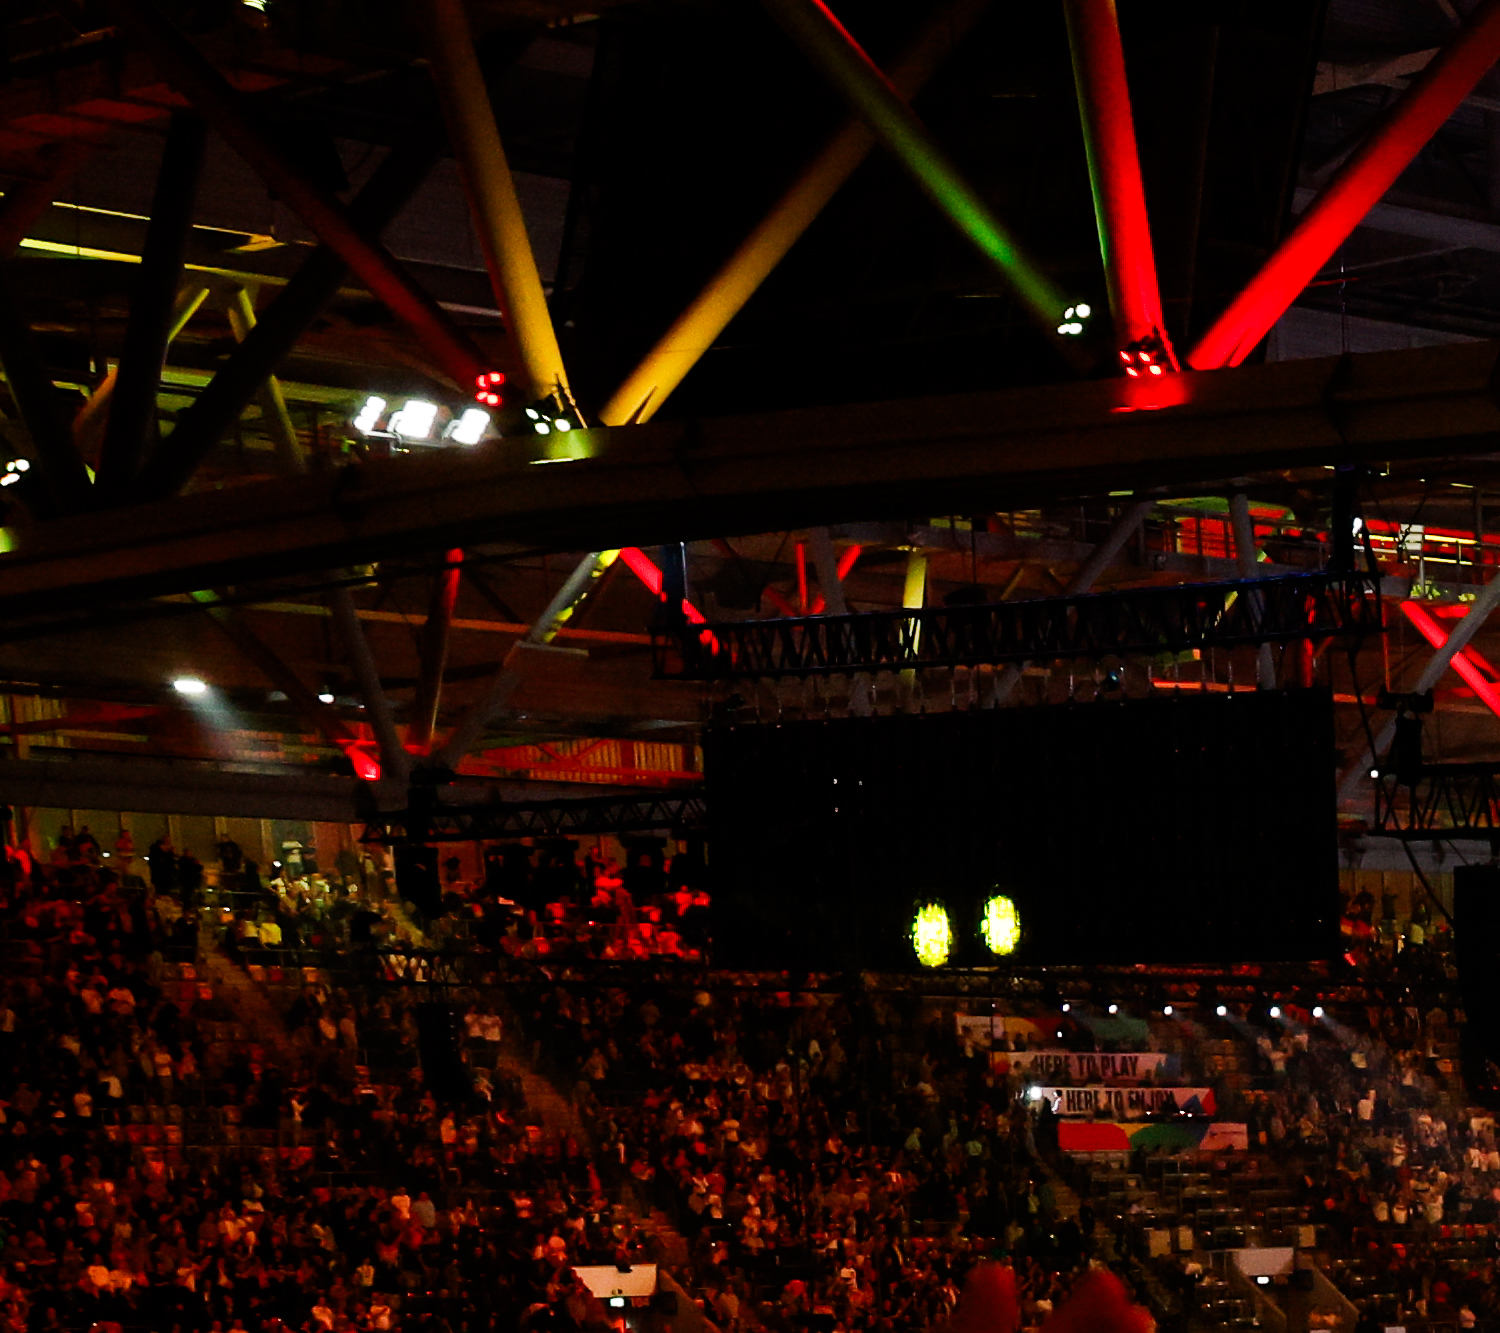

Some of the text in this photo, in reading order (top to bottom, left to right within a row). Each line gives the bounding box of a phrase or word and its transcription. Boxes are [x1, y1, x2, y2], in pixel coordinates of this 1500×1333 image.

[1035, 1055, 1139, 1077] HERE TO PLAY
[1066, 1089, 1098, 1112] HERE
[1104, 1090, 1123, 1111] TO
